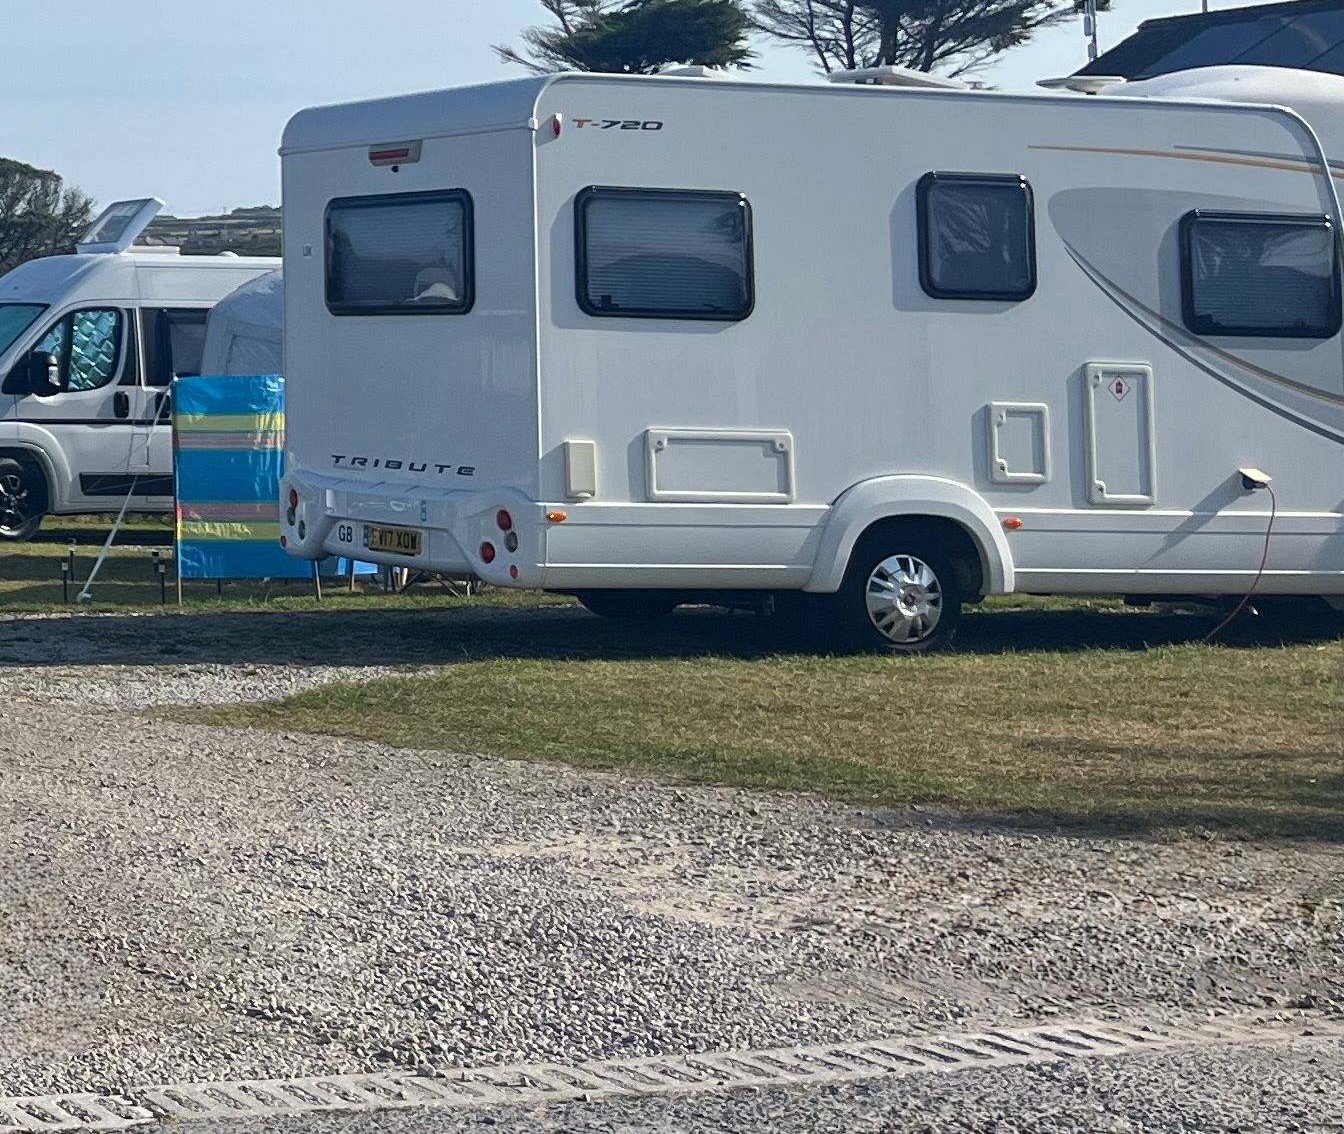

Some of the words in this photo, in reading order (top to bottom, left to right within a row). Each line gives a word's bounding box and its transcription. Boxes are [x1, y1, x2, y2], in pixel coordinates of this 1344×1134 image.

[572, 118, 664, 131] T-720
[331, 454, 477, 477] TRIBUTE
[338, 524, 353, 543] GB
